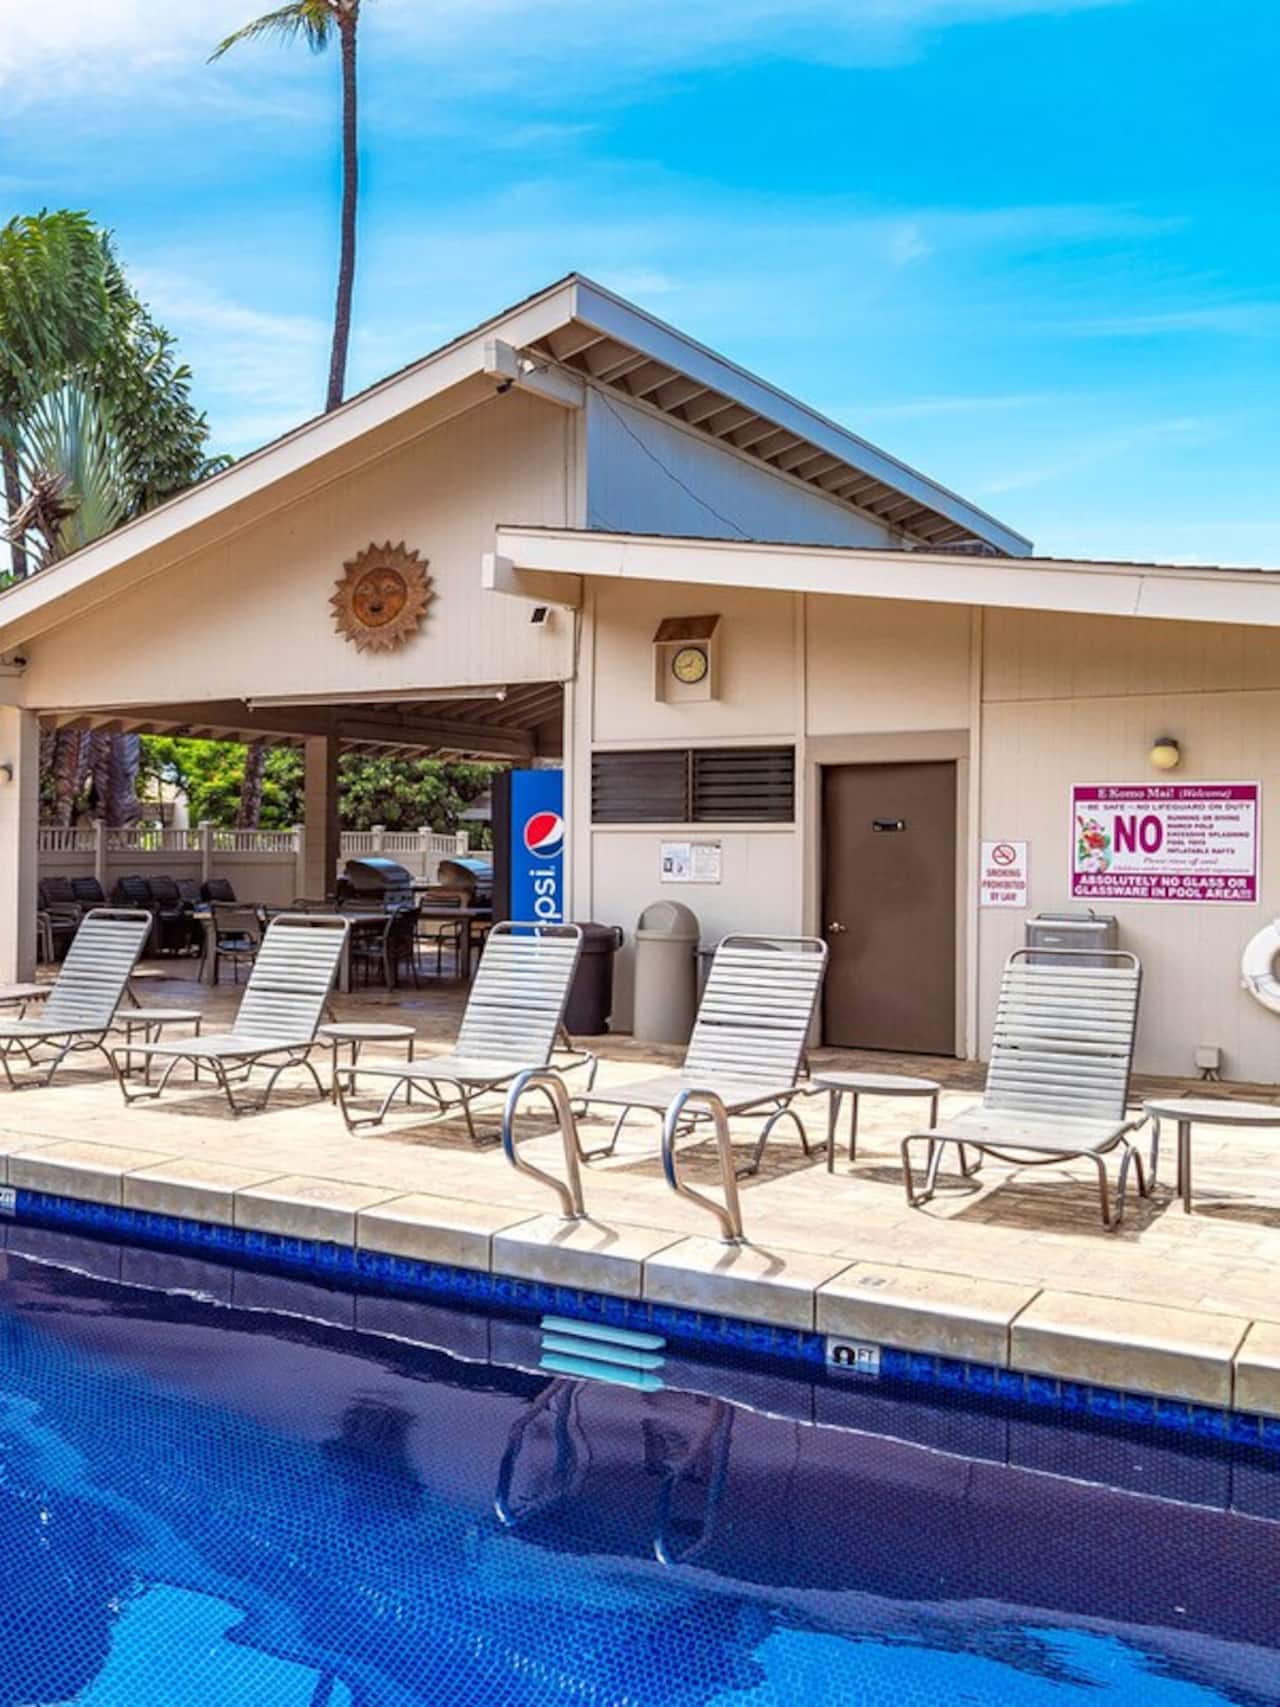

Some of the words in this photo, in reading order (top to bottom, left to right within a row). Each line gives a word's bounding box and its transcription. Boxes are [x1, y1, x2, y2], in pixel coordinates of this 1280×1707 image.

[1178, 788, 1232, 798] (Welcome)
[1113, 814, 1163, 854] NO
[986, 868, 1022, 877] SMOKING
[982, 880, 1025, 890] PROHIBITED
[1079, 875, 1158, 887] ABSOLUTELY
[1161, 876, 1180, 887] NO
[1183, 877, 1226, 888] GLASS
[1227, 878, 1248, 889] OR
[989, 892, 999, 901] BY
[1001, 892, 1017, 901] LAW
[1075, 885, 1149, 897] GLASSWARE
[1151, 886, 1167, 897] IN
[1168, 887, 1203, 898] POOL
